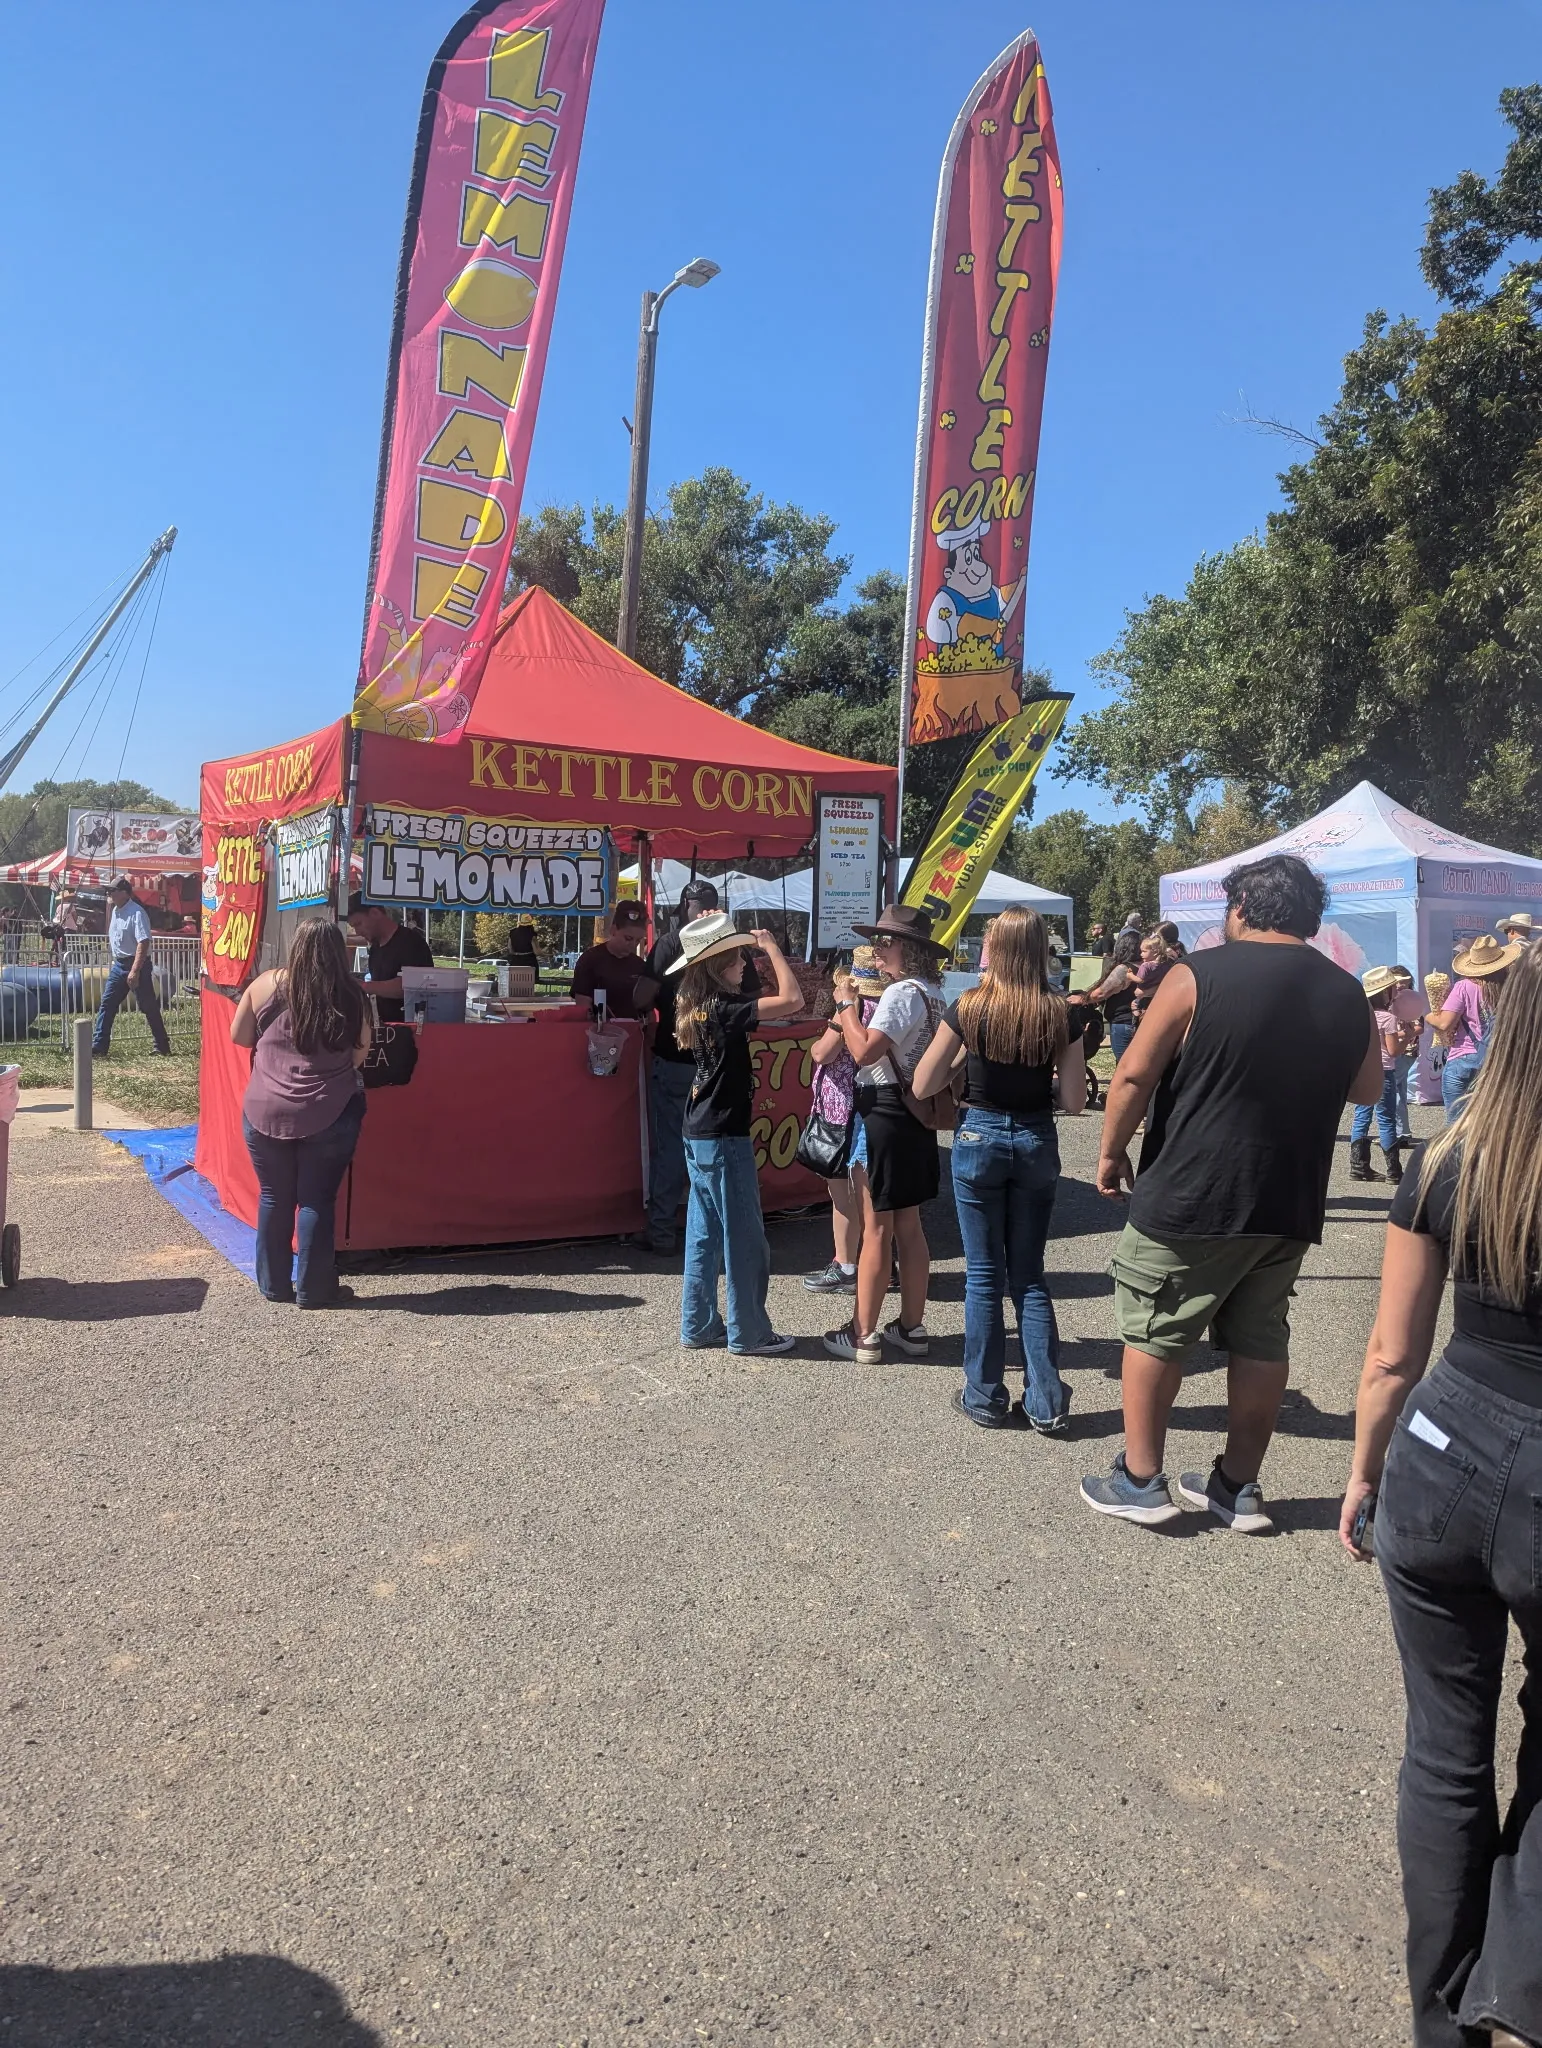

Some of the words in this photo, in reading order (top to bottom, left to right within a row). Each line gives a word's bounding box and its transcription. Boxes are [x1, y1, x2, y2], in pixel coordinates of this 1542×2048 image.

[931, 470, 1035, 534] CORN
[224, 758, 274, 806] KETTLE
[276, 742, 315, 800] CORN
[469, 738, 682, 806] KETTLE
[692, 765, 815, 818] CORN
[977, 763, 1004, 778] Let's
[1006, 760, 1032, 774] Play
[824, 809, 874, 820] SQUEEZED
[832, 799, 863, 810] FRESH
[121, 827, 168, 842] $5.00
[372, 810, 464, 844] FRESH
[467, 823, 604, 850] SQUEEZED
[829, 826, 869, 835] LEMONADE
[955, 796, 1008, 891] YUBA-SUTTER
[368, 843, 605, 907] LEMONADE
[919, 787, 996, 932] yzeum
[1172, 880, 1202, 903] SPUN
[1205, 878, 1228, 900] CRA
[1442, 864, 1478, 894] COTTON
[1480, 867, 1514, 896] CANDY
[363, 1047, 389, 1068] EA
